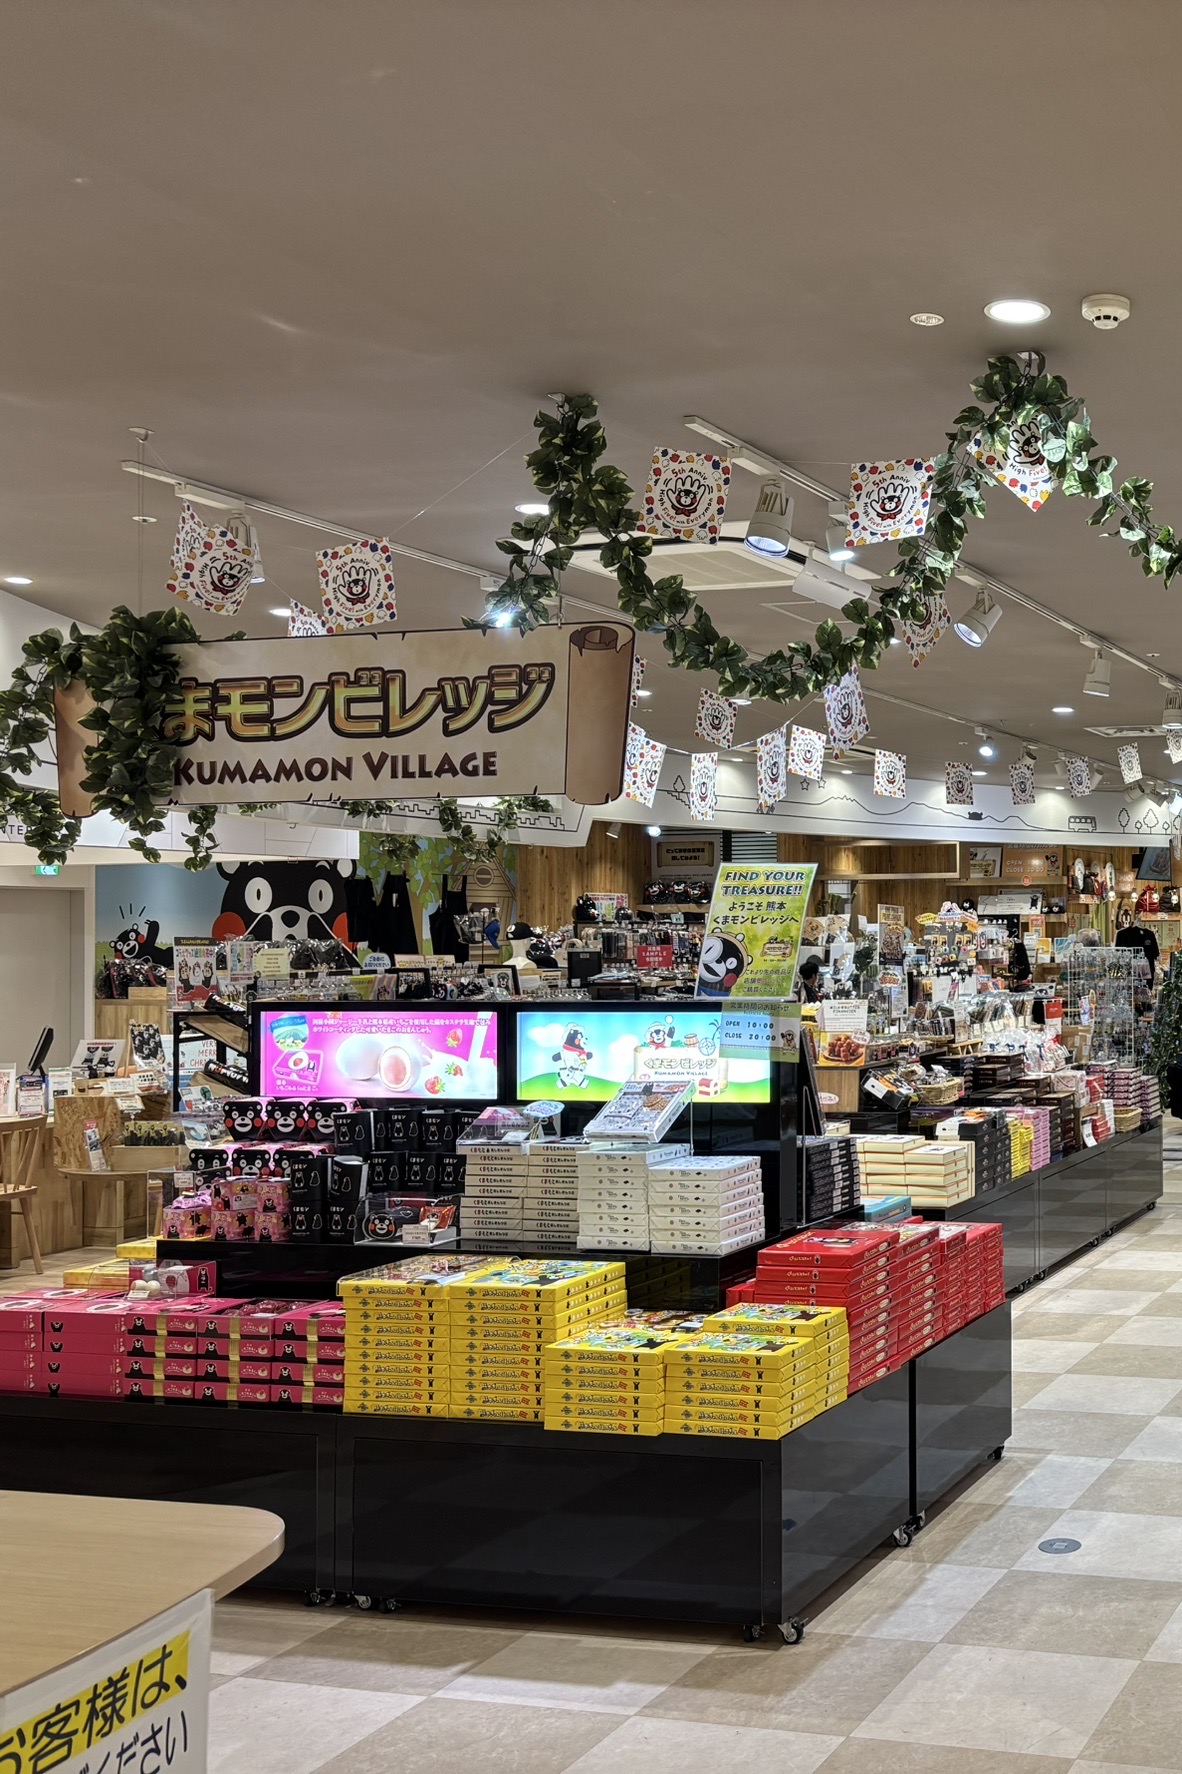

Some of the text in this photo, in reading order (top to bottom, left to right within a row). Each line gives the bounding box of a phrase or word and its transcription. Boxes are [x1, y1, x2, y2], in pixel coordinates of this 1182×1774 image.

[672, 467, 686, 477] 5th
[1009, 463, 1048, 476] High Five!
[872, 477, 887, 488] 5th
[658, 489, 666, 507] High
[662, 507, 676, 522] Five!
[686, 497, 713, 525] Everymon
[868, 517, 882, 528] Five!
[893, 496, 917, 525] Everymon
[223, 552, 238, 561] 5th
[199, 562, 210, 578] High
[336, 562, 349, 572] 5th
[200, 580, 213, 596] Five!
[332, 587, 340, 603] High
[340, 602, 355, 613] Five!
[163, 661, 553, 743] まモンビレッジ
[174, 750, 498, 786] KUMAMON VILLAGE
[724, 871, 806, 882] FIND YOUR
[722, 884, 803, 897] TREASURE!!
[728, 900, 787, 912] ようこそ 熊本
[712, 914, 799, 926] くまモンビレッジへ
[643, 1057, 718, 1070] くまモンビレッジ
[80, 1711, 188, 1774] ださい
